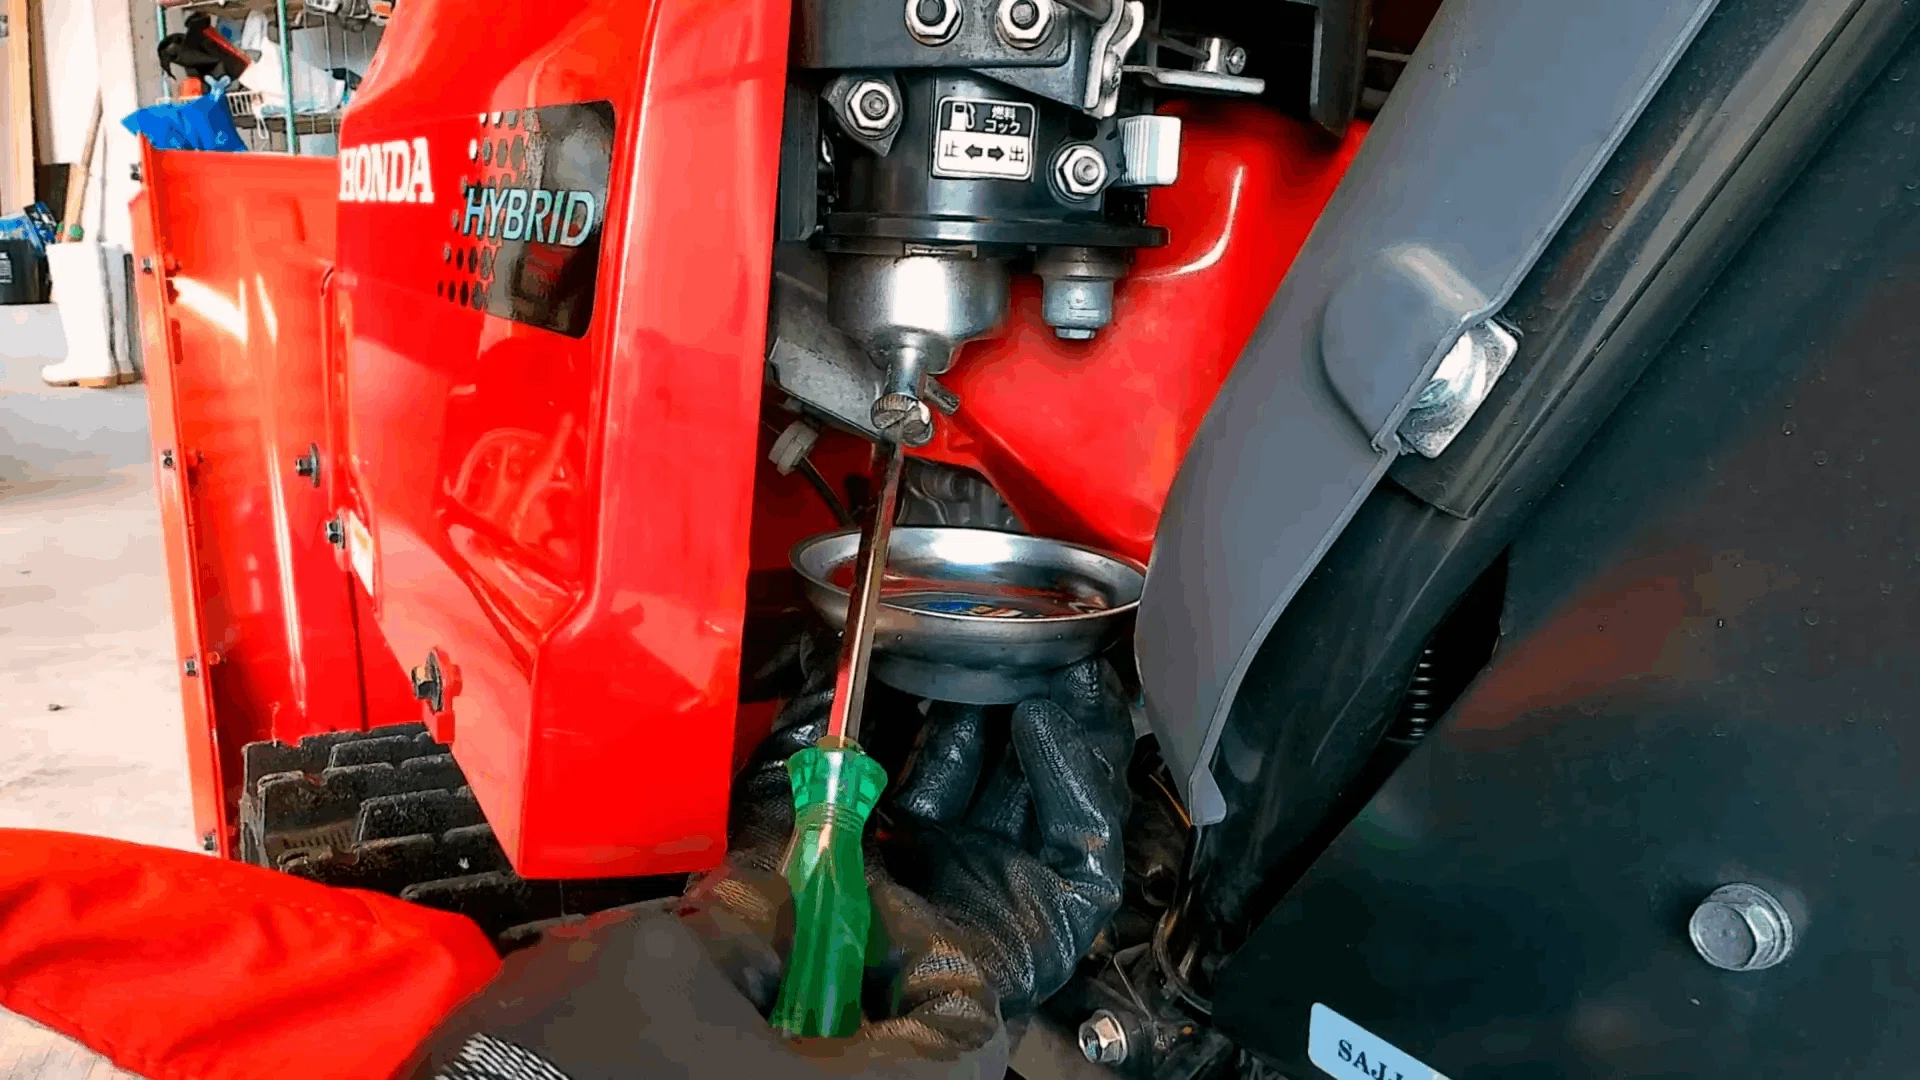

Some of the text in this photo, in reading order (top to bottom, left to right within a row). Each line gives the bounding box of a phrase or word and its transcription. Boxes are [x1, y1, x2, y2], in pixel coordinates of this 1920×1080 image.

[984, 119, 1021, 134] コック
[339, 136, 434, 204] HONDA
[944, 141, 1025, 162] 止 出
[463, 187, 597, 248] HYBRID
